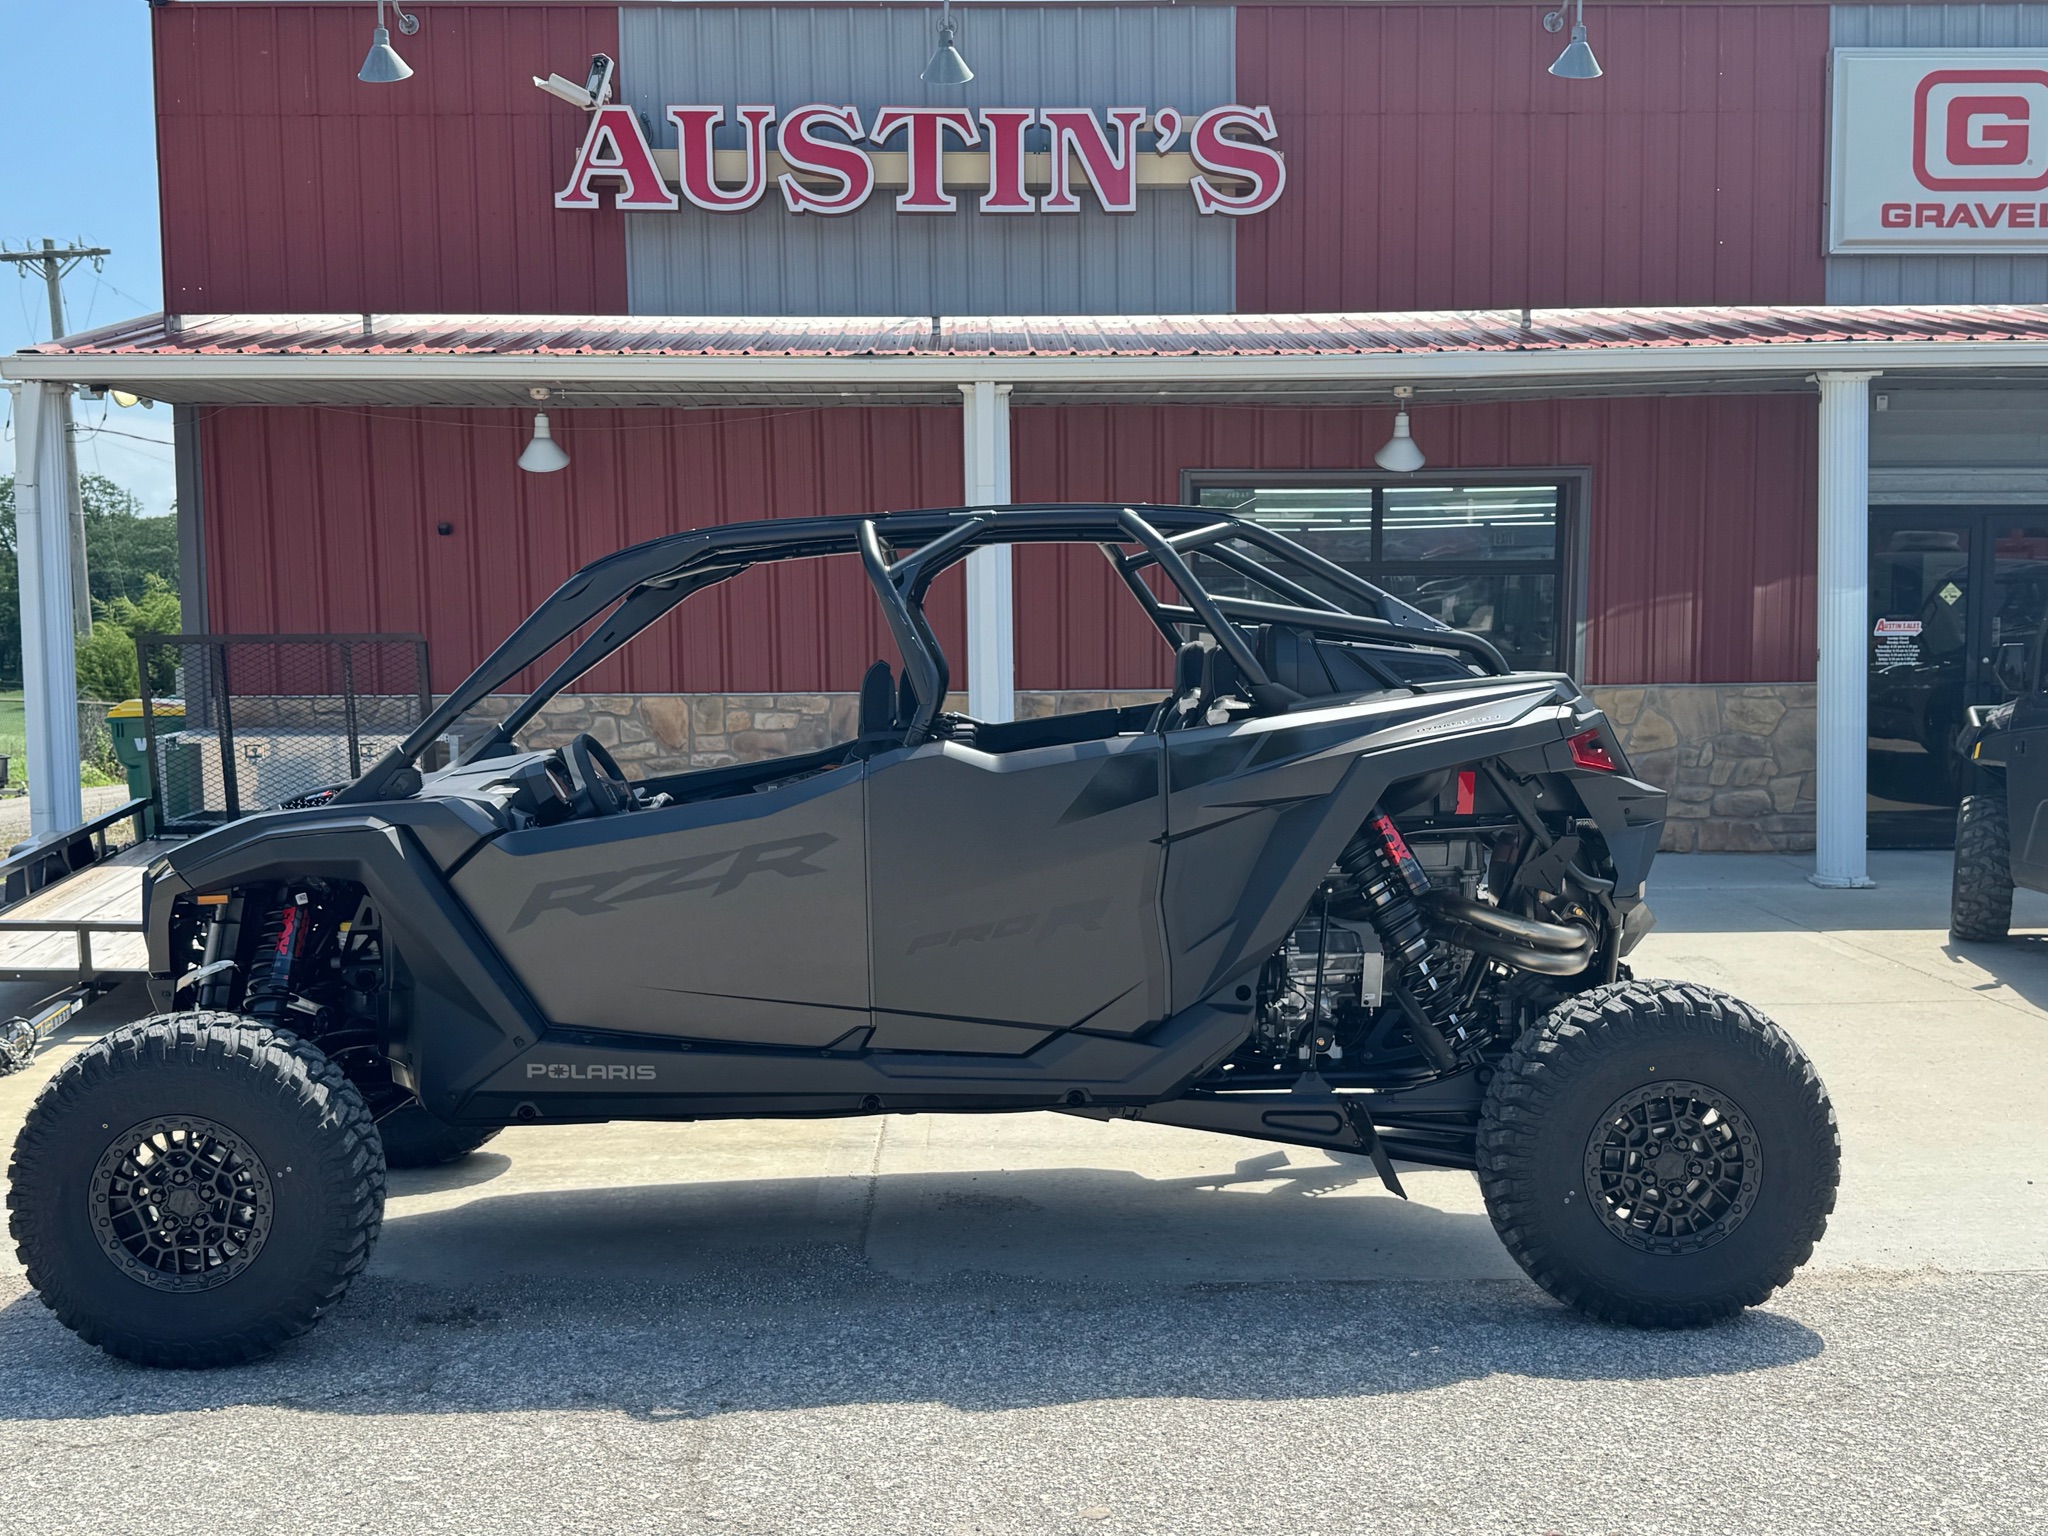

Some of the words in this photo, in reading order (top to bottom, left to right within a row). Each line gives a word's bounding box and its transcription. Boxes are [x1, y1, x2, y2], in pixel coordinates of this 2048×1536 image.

[555, 105, 1286, 215] AUSTIN'S
[506, 832, 839, 935] RZR
[905, 912, 1041, 956] PRO
[526, 1063, 657, 1080] POLARIS
